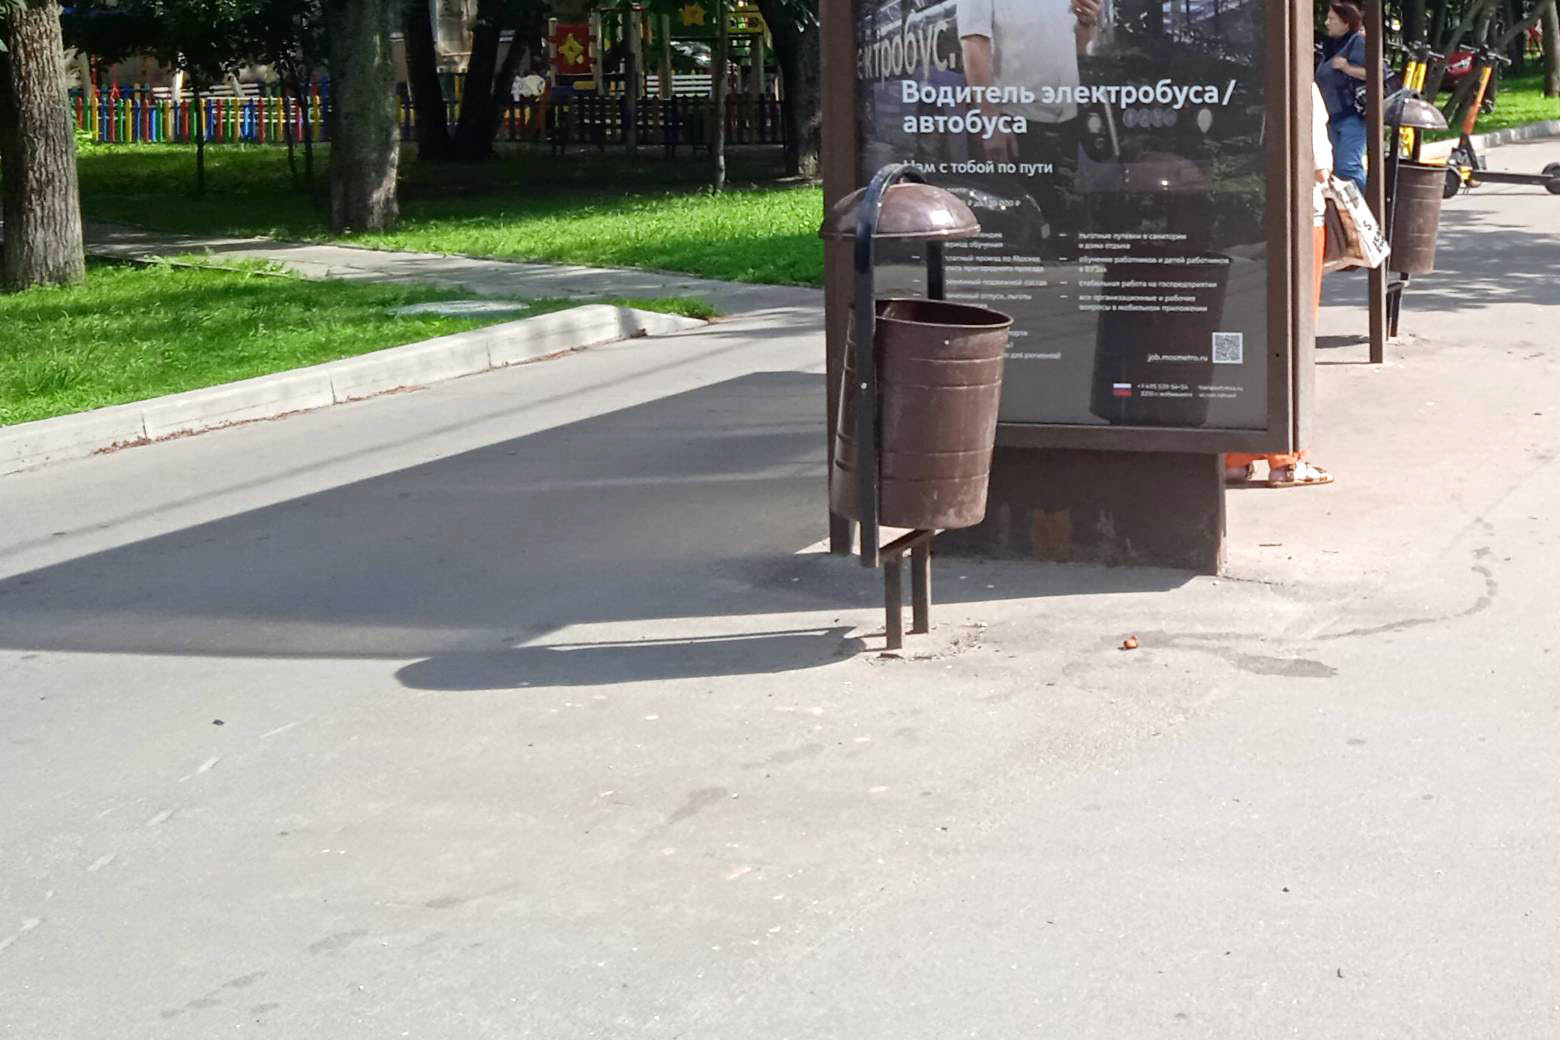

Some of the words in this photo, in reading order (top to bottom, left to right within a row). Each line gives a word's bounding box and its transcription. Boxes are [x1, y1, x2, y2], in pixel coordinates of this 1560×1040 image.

[902, 80, 1034, 108] Водитель
[1042, 78, 1237, 109] электробуса/
[903, 110, 1028, 138] автобуса
[939, 163, 947, 174] с
[951, 160, 995, 174] тобой
[998, 163, 1016, 174] по
[1018, 163, 1054, 177] пути
